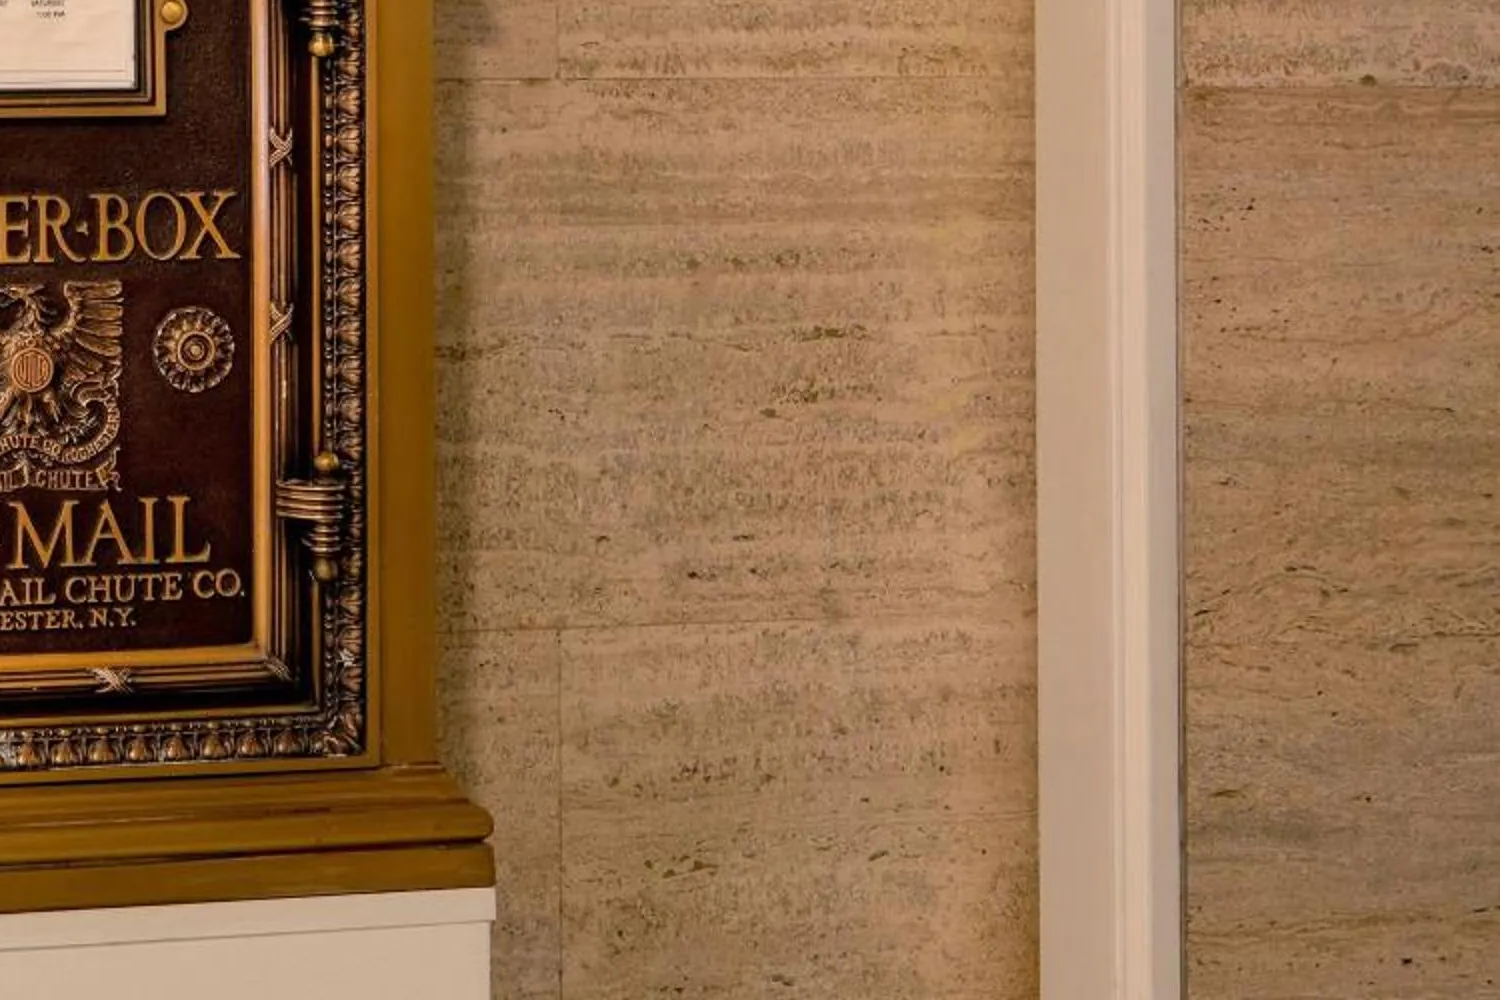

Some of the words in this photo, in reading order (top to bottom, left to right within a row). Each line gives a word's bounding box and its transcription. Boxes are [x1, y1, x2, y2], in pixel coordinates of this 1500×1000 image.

[35, 469, 94, 489] CHUTE
[64, 571, 184, 604] CHUTE
[192, 567, 246, 600] CO.
[89, 607, 138, 629] N.Y.
